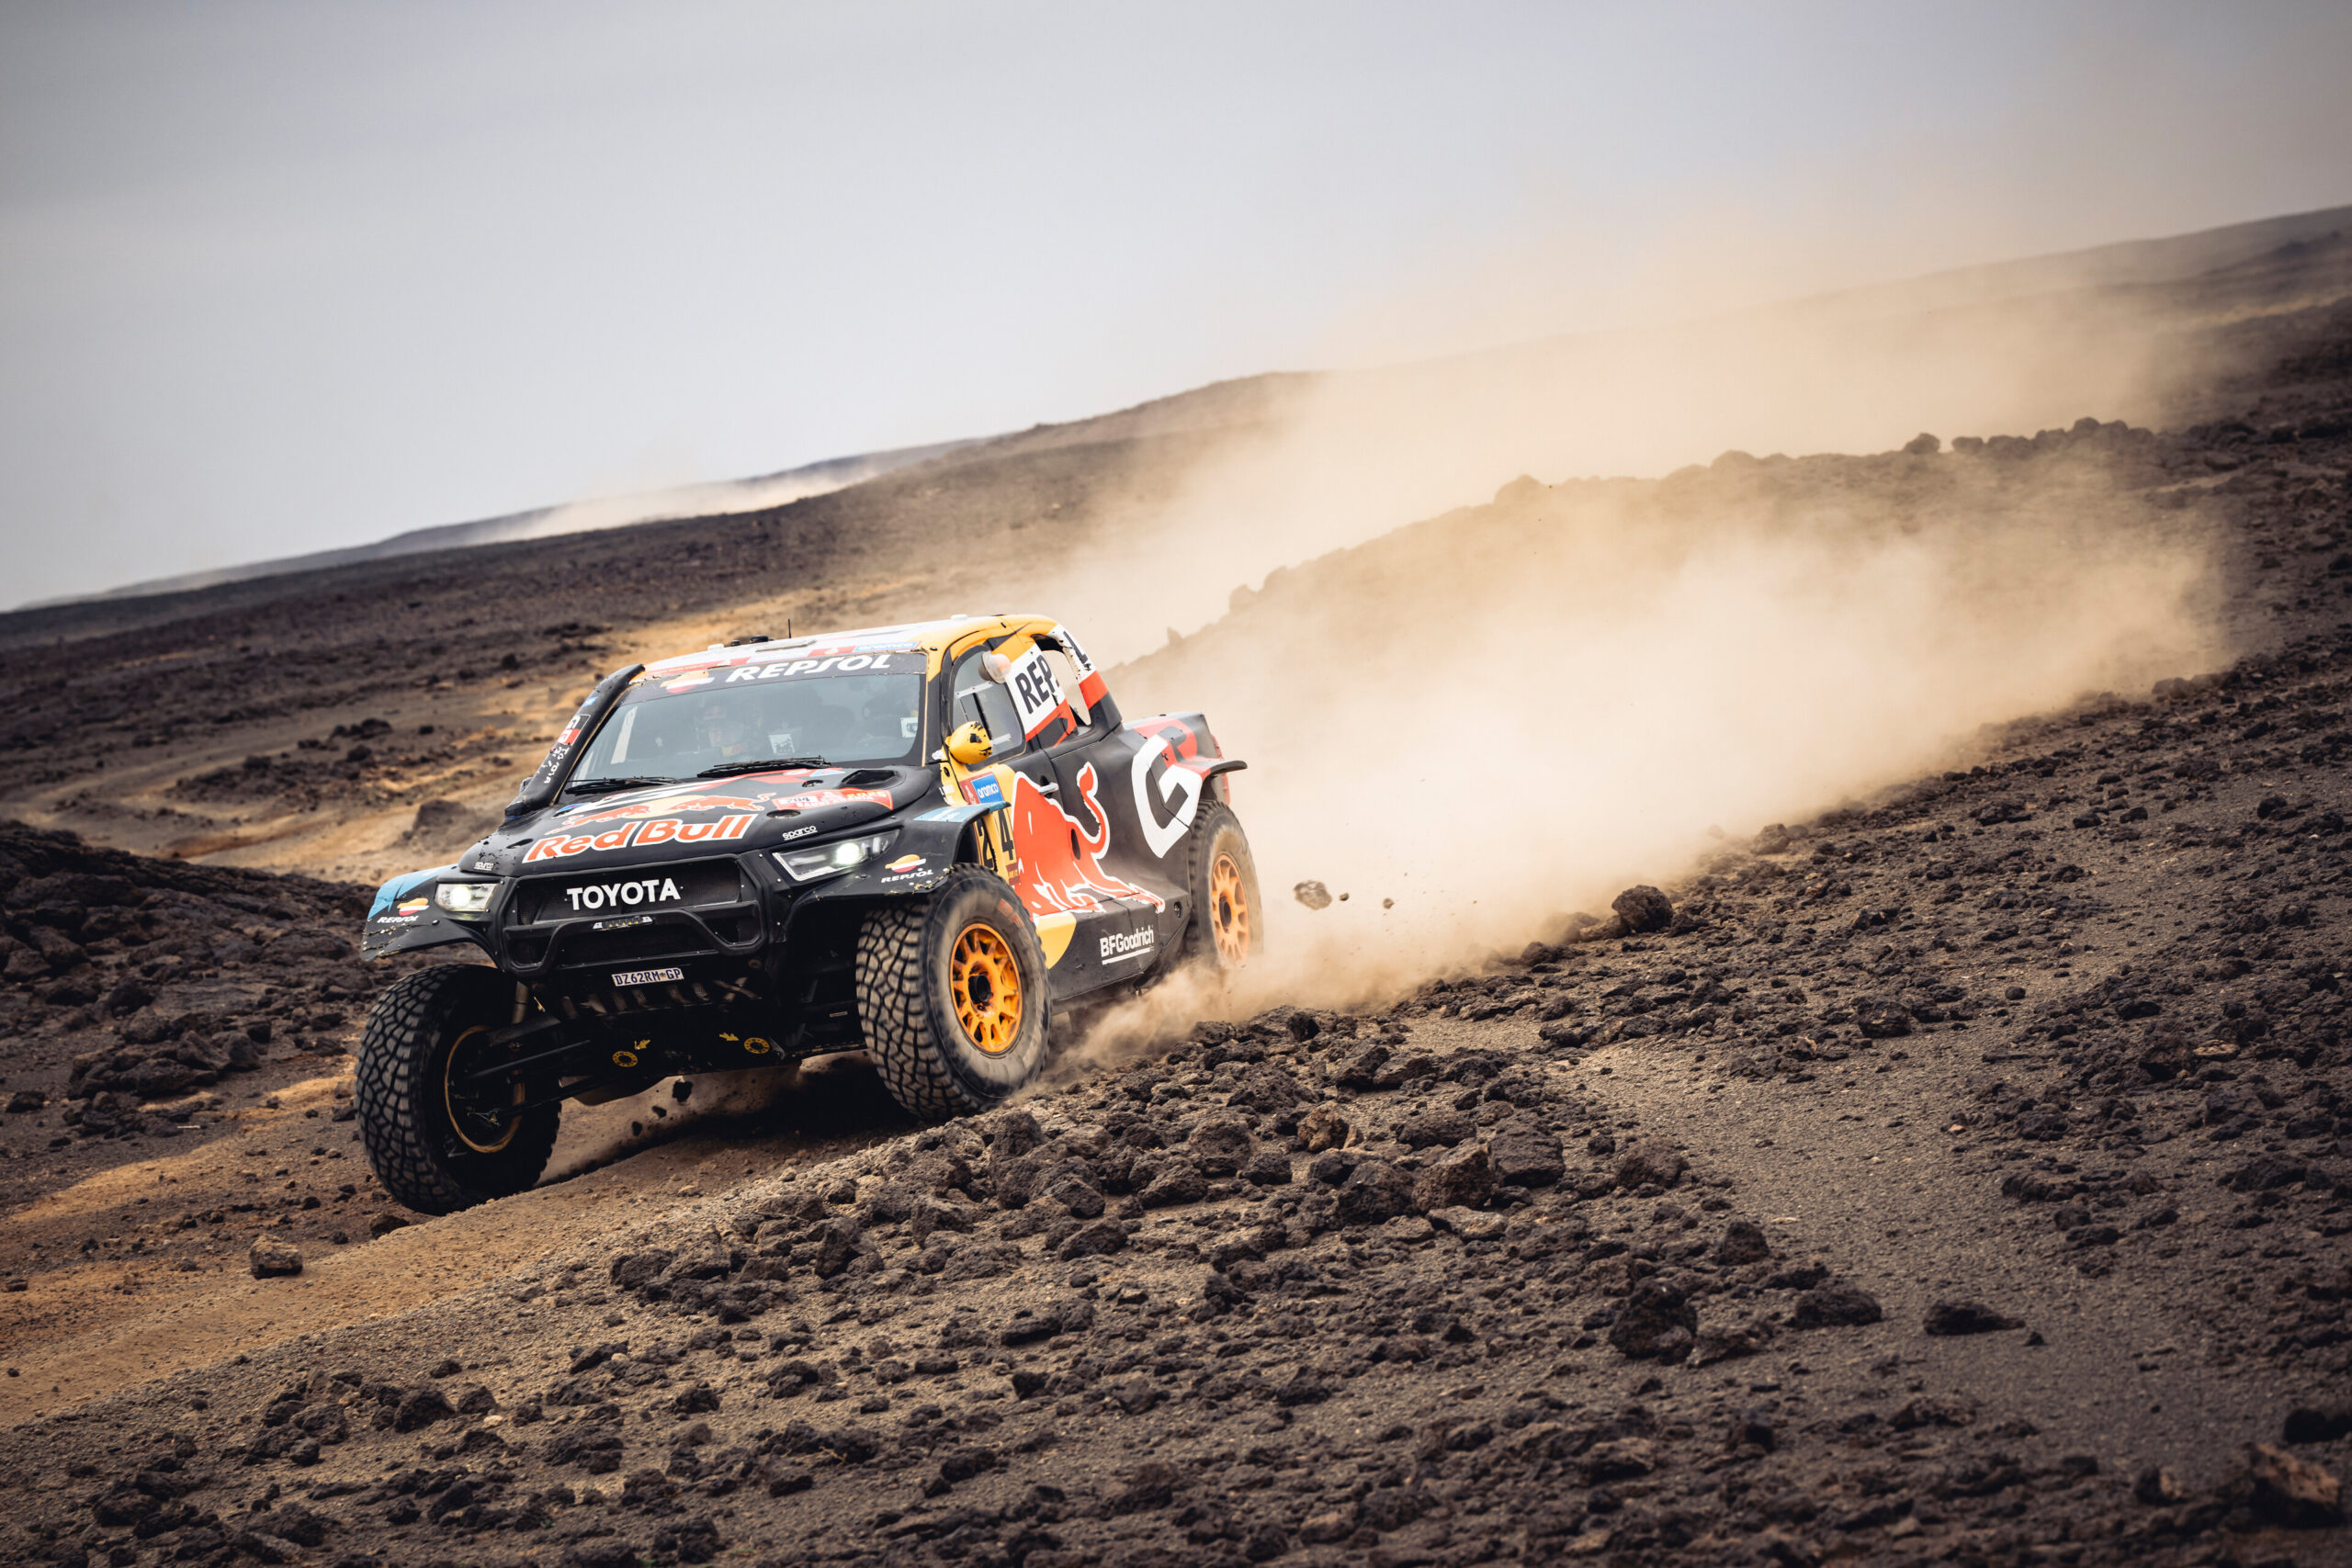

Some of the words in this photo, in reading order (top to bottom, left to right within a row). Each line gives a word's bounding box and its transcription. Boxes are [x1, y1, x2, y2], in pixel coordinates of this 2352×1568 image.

[725, 654, 891, 682] REPSOL
[977, 783, 999, 798] aramco
[522, 822, 634, 863] Red
[631, 813, 758, 847] Bull
[782, 825, 818, 840] sparco
[881, 869, 934, 883] REPSOL
[566, 877, 682, 910] TOYOTA
[376, 915, 420, 923] REPSOL
[1100, 924, 1155, 957] BFGoodrich
